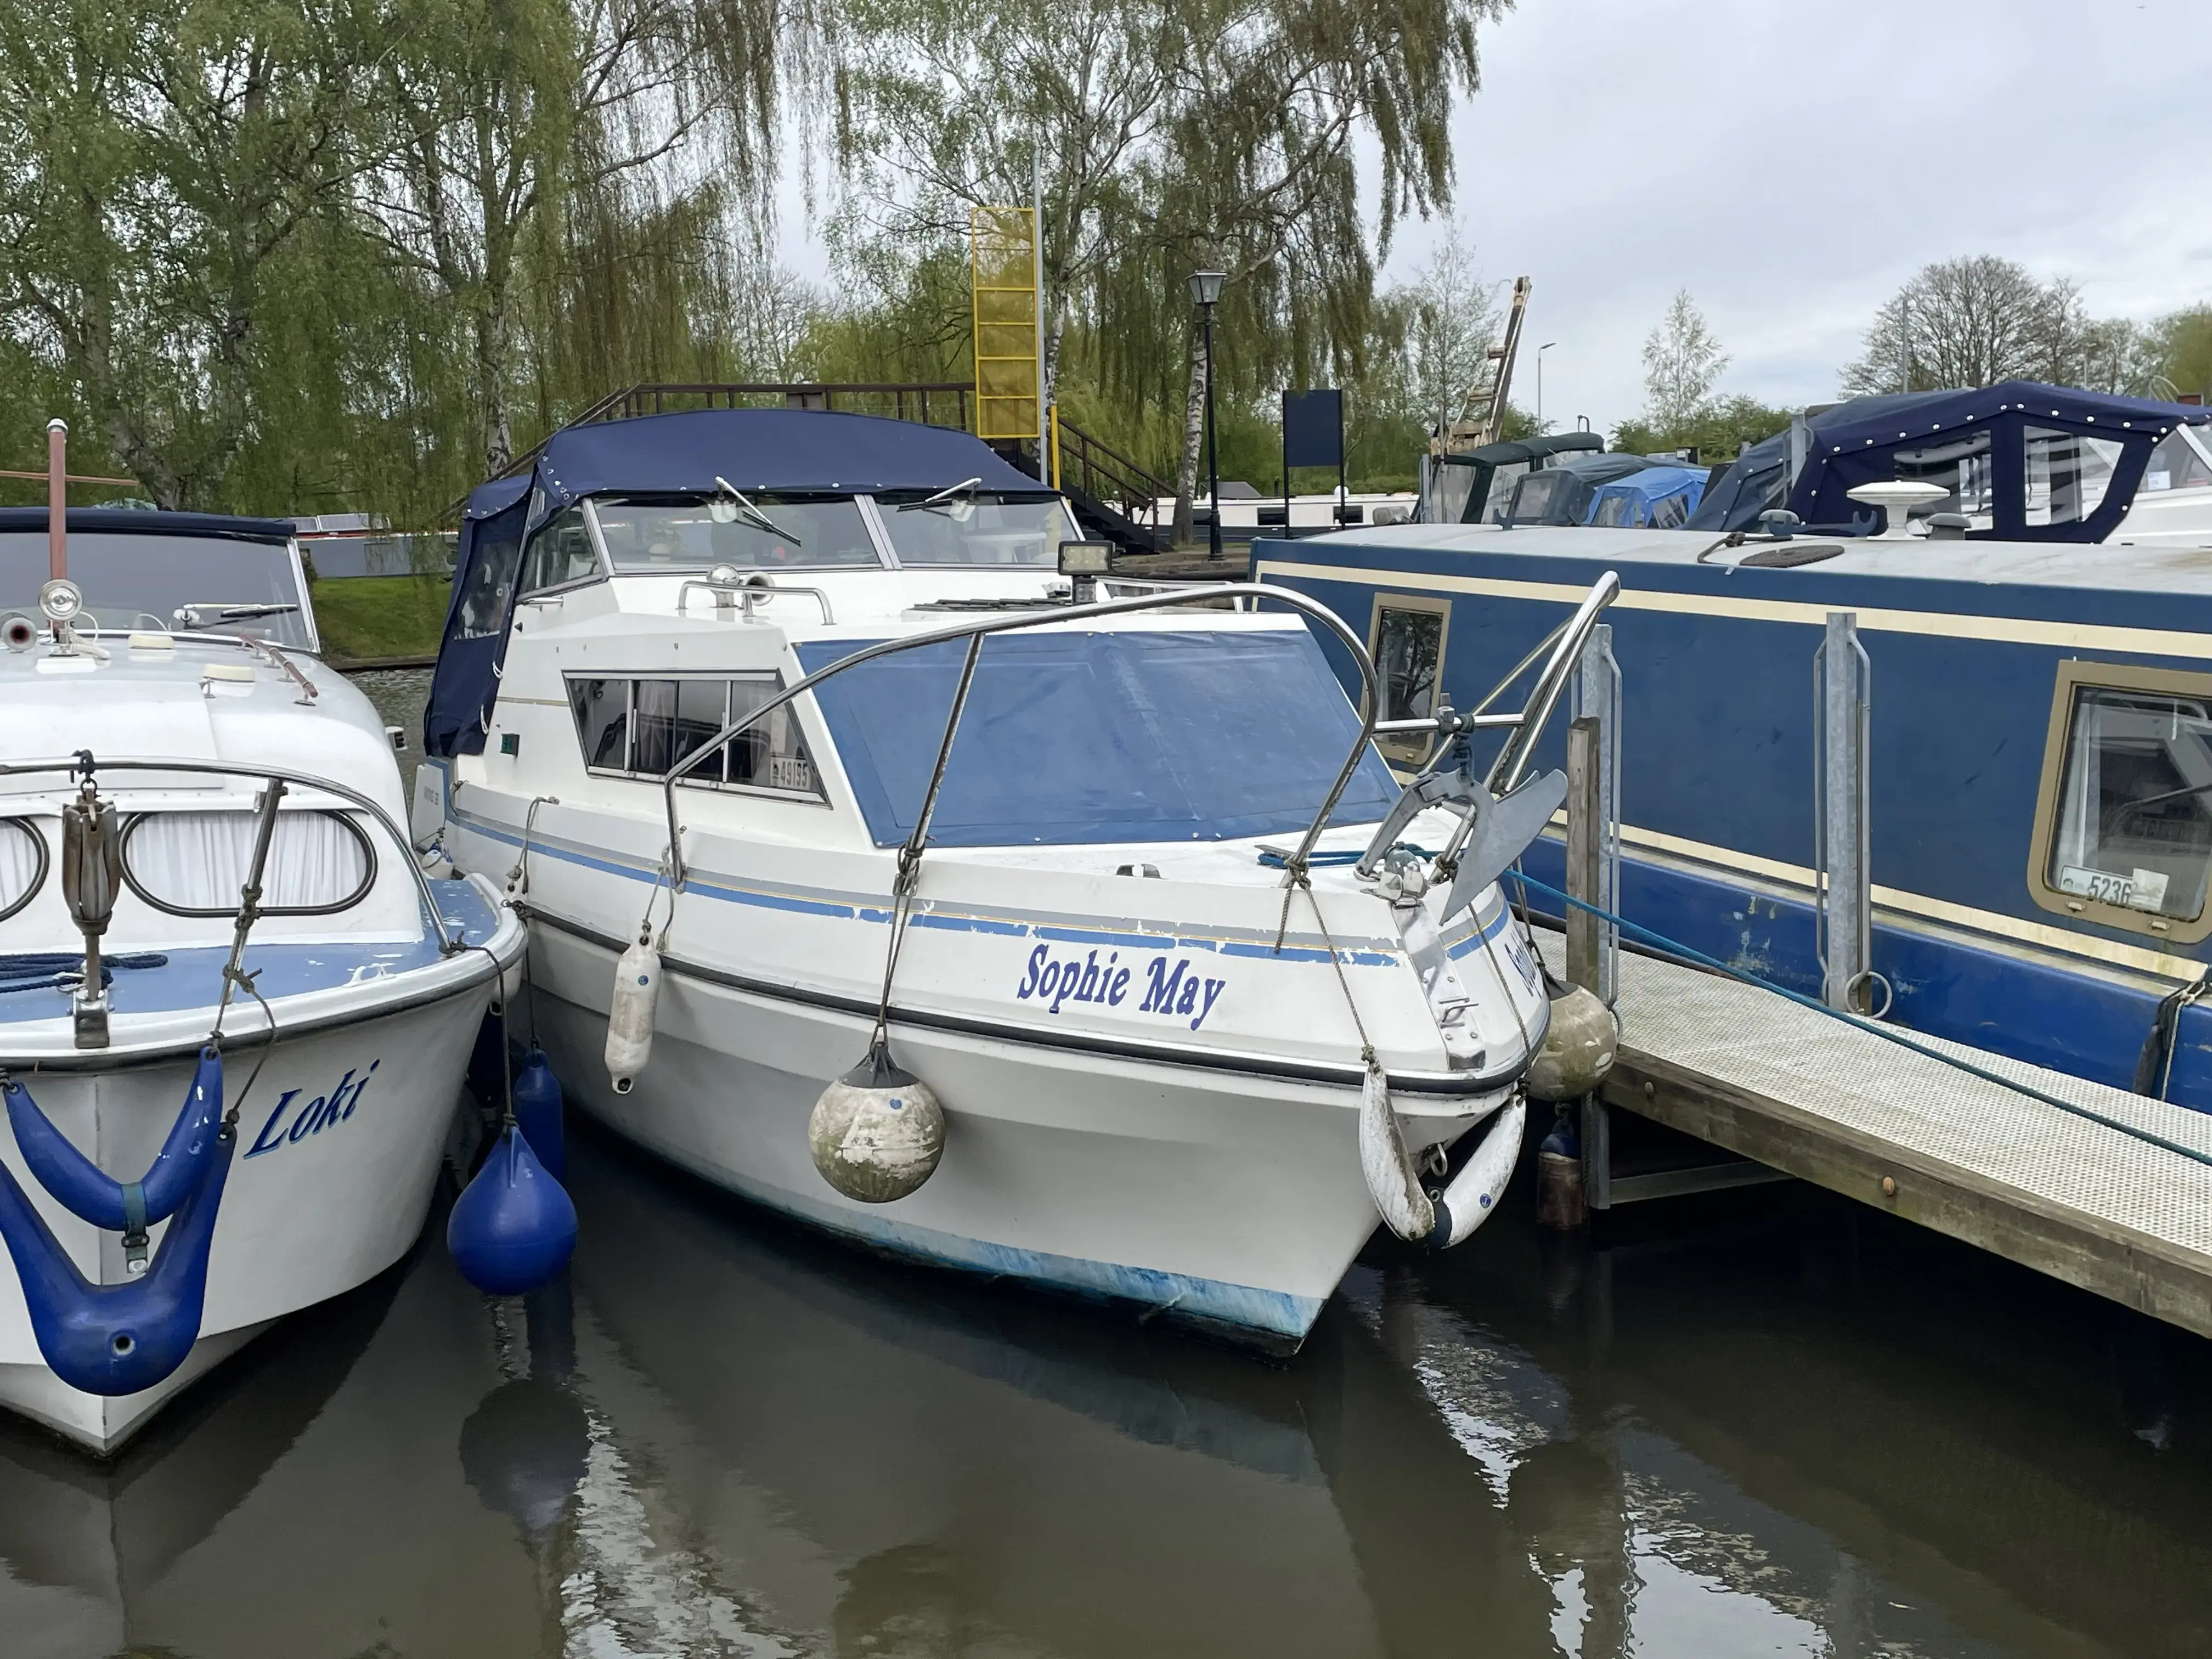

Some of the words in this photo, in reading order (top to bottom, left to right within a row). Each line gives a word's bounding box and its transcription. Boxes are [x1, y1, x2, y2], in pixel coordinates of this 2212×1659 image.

[780, 761, 808, 787] 49195
[1017, 944, 1131, 1014] Sophie
[1139, 956, 1226, 1031] May
[243, 1058, 380, 1160] Loki
